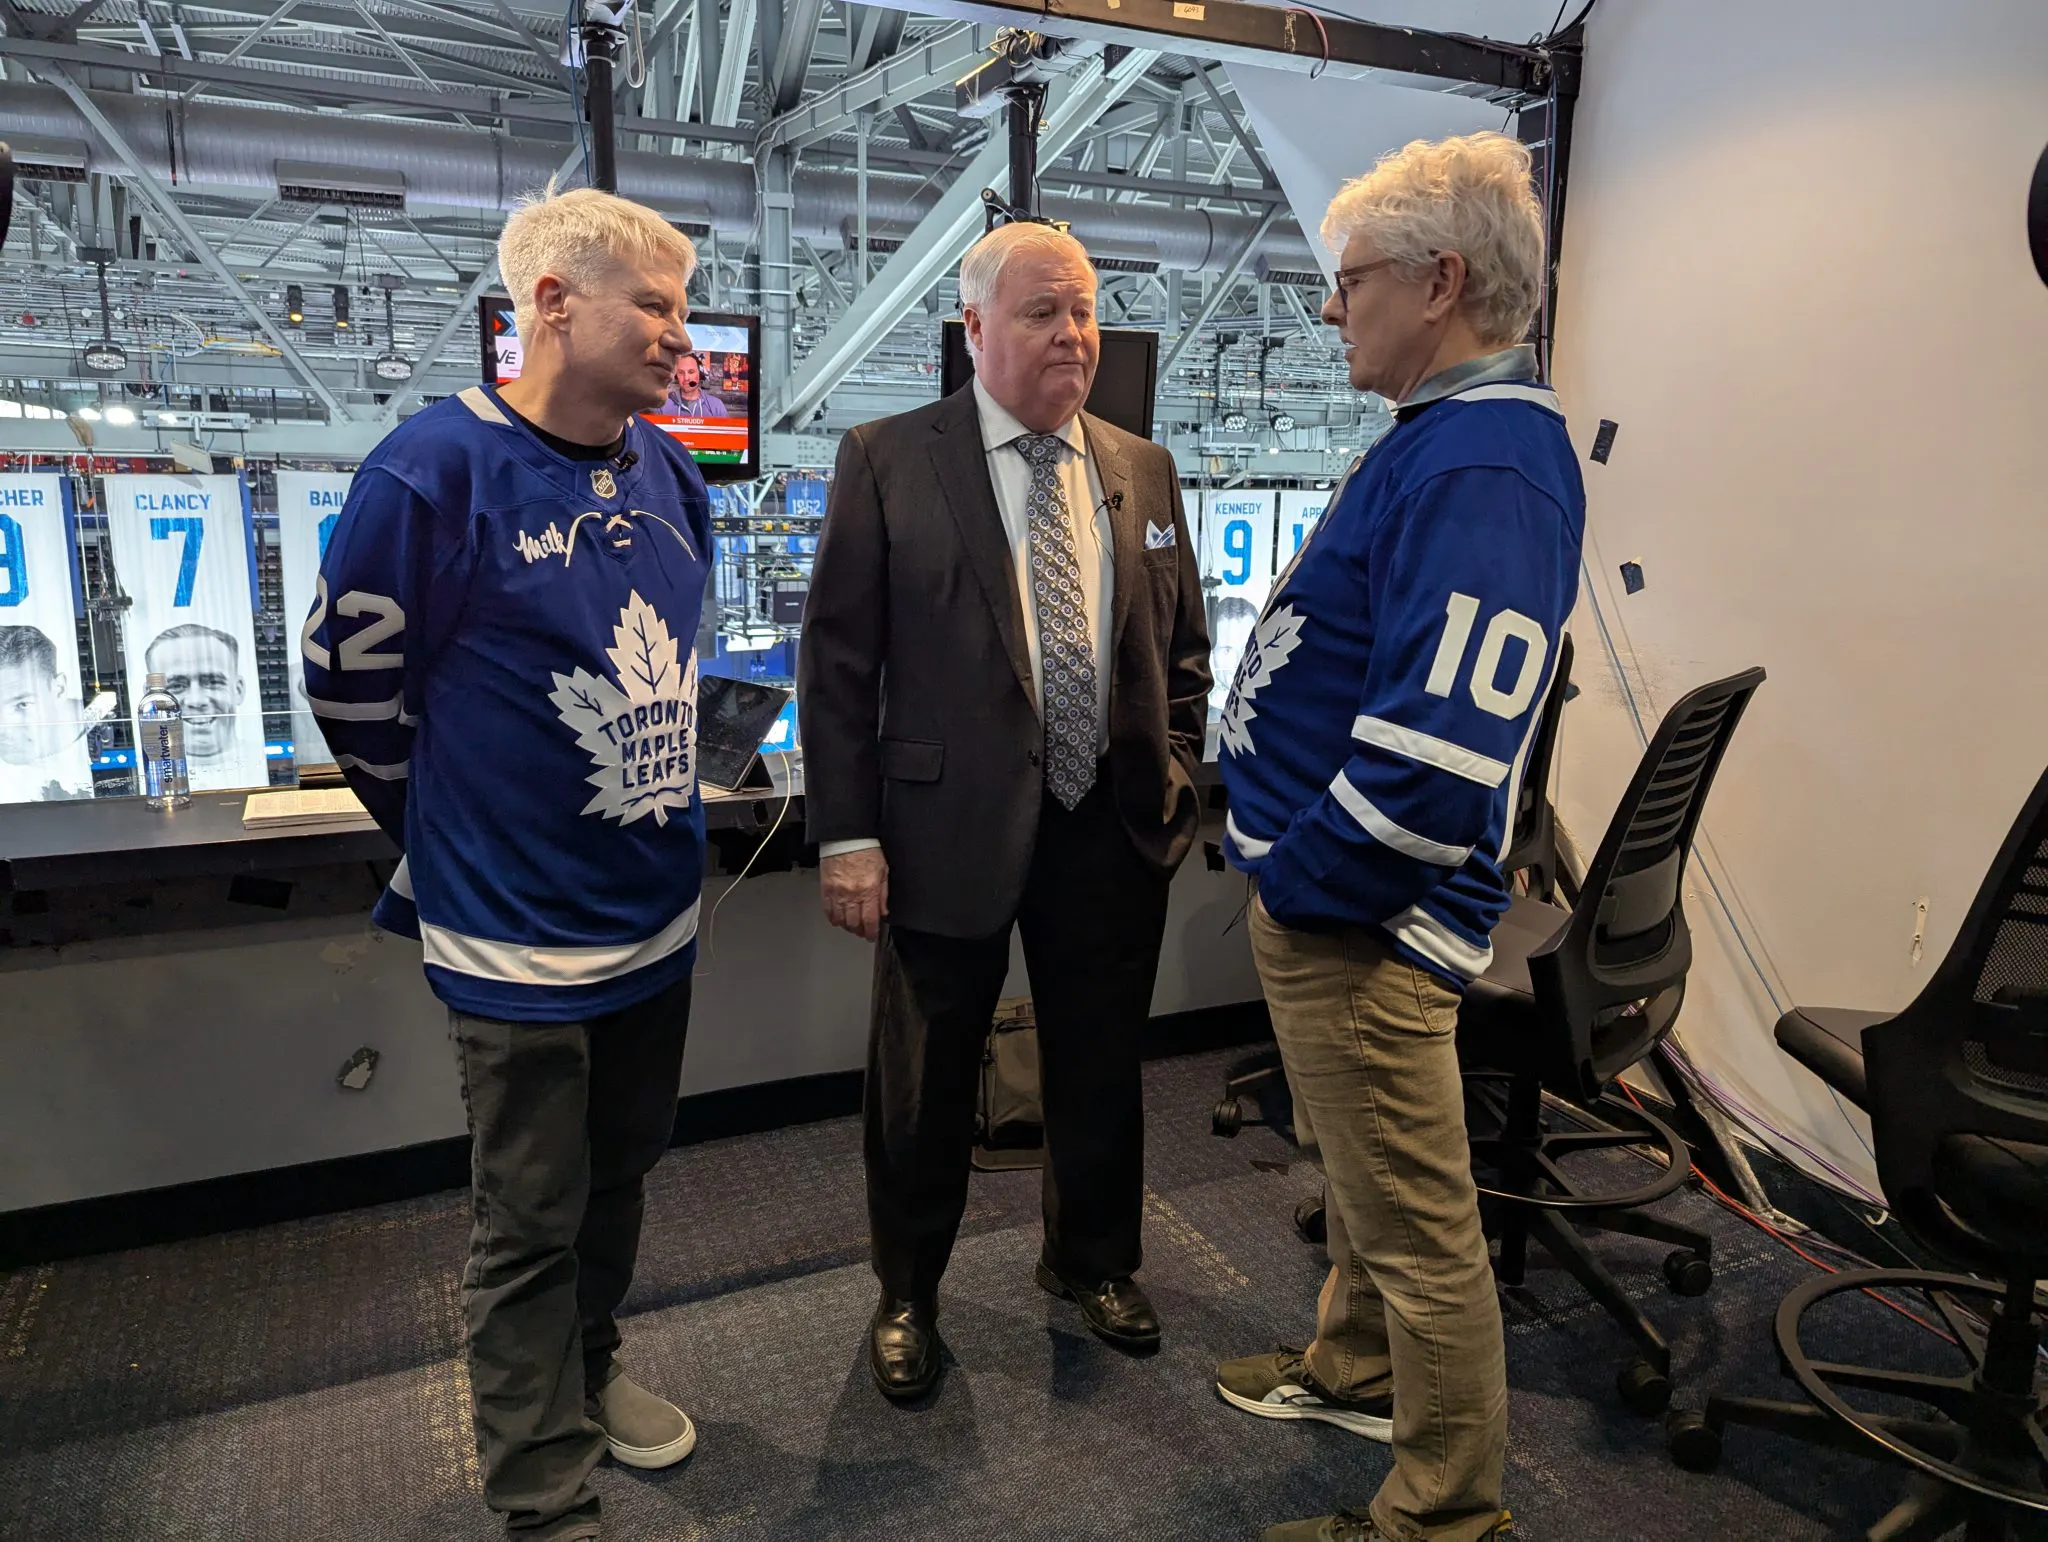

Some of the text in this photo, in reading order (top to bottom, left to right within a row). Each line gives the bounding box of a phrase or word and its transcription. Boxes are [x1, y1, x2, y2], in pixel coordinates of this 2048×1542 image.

[135, 494, 211, 511] CLANCY
[792, 499, 822, 515] 1962
[1215, 503, 1263, 515] KENNEDY
[1301, 507, 1324, 519] APP
[150, 517, 205, 608] 7
[1222, 520, 1253, 586] 9
[301, 573, 405, 671] 22
[1425, 591, 1549, 721] 10
[598, 699, 693, 746] TORONTO
[159, 725, 173, 784] smartwater
[621, 728, 689, 764] MAPLE
[622, 753, 689, 789] LEAFS
